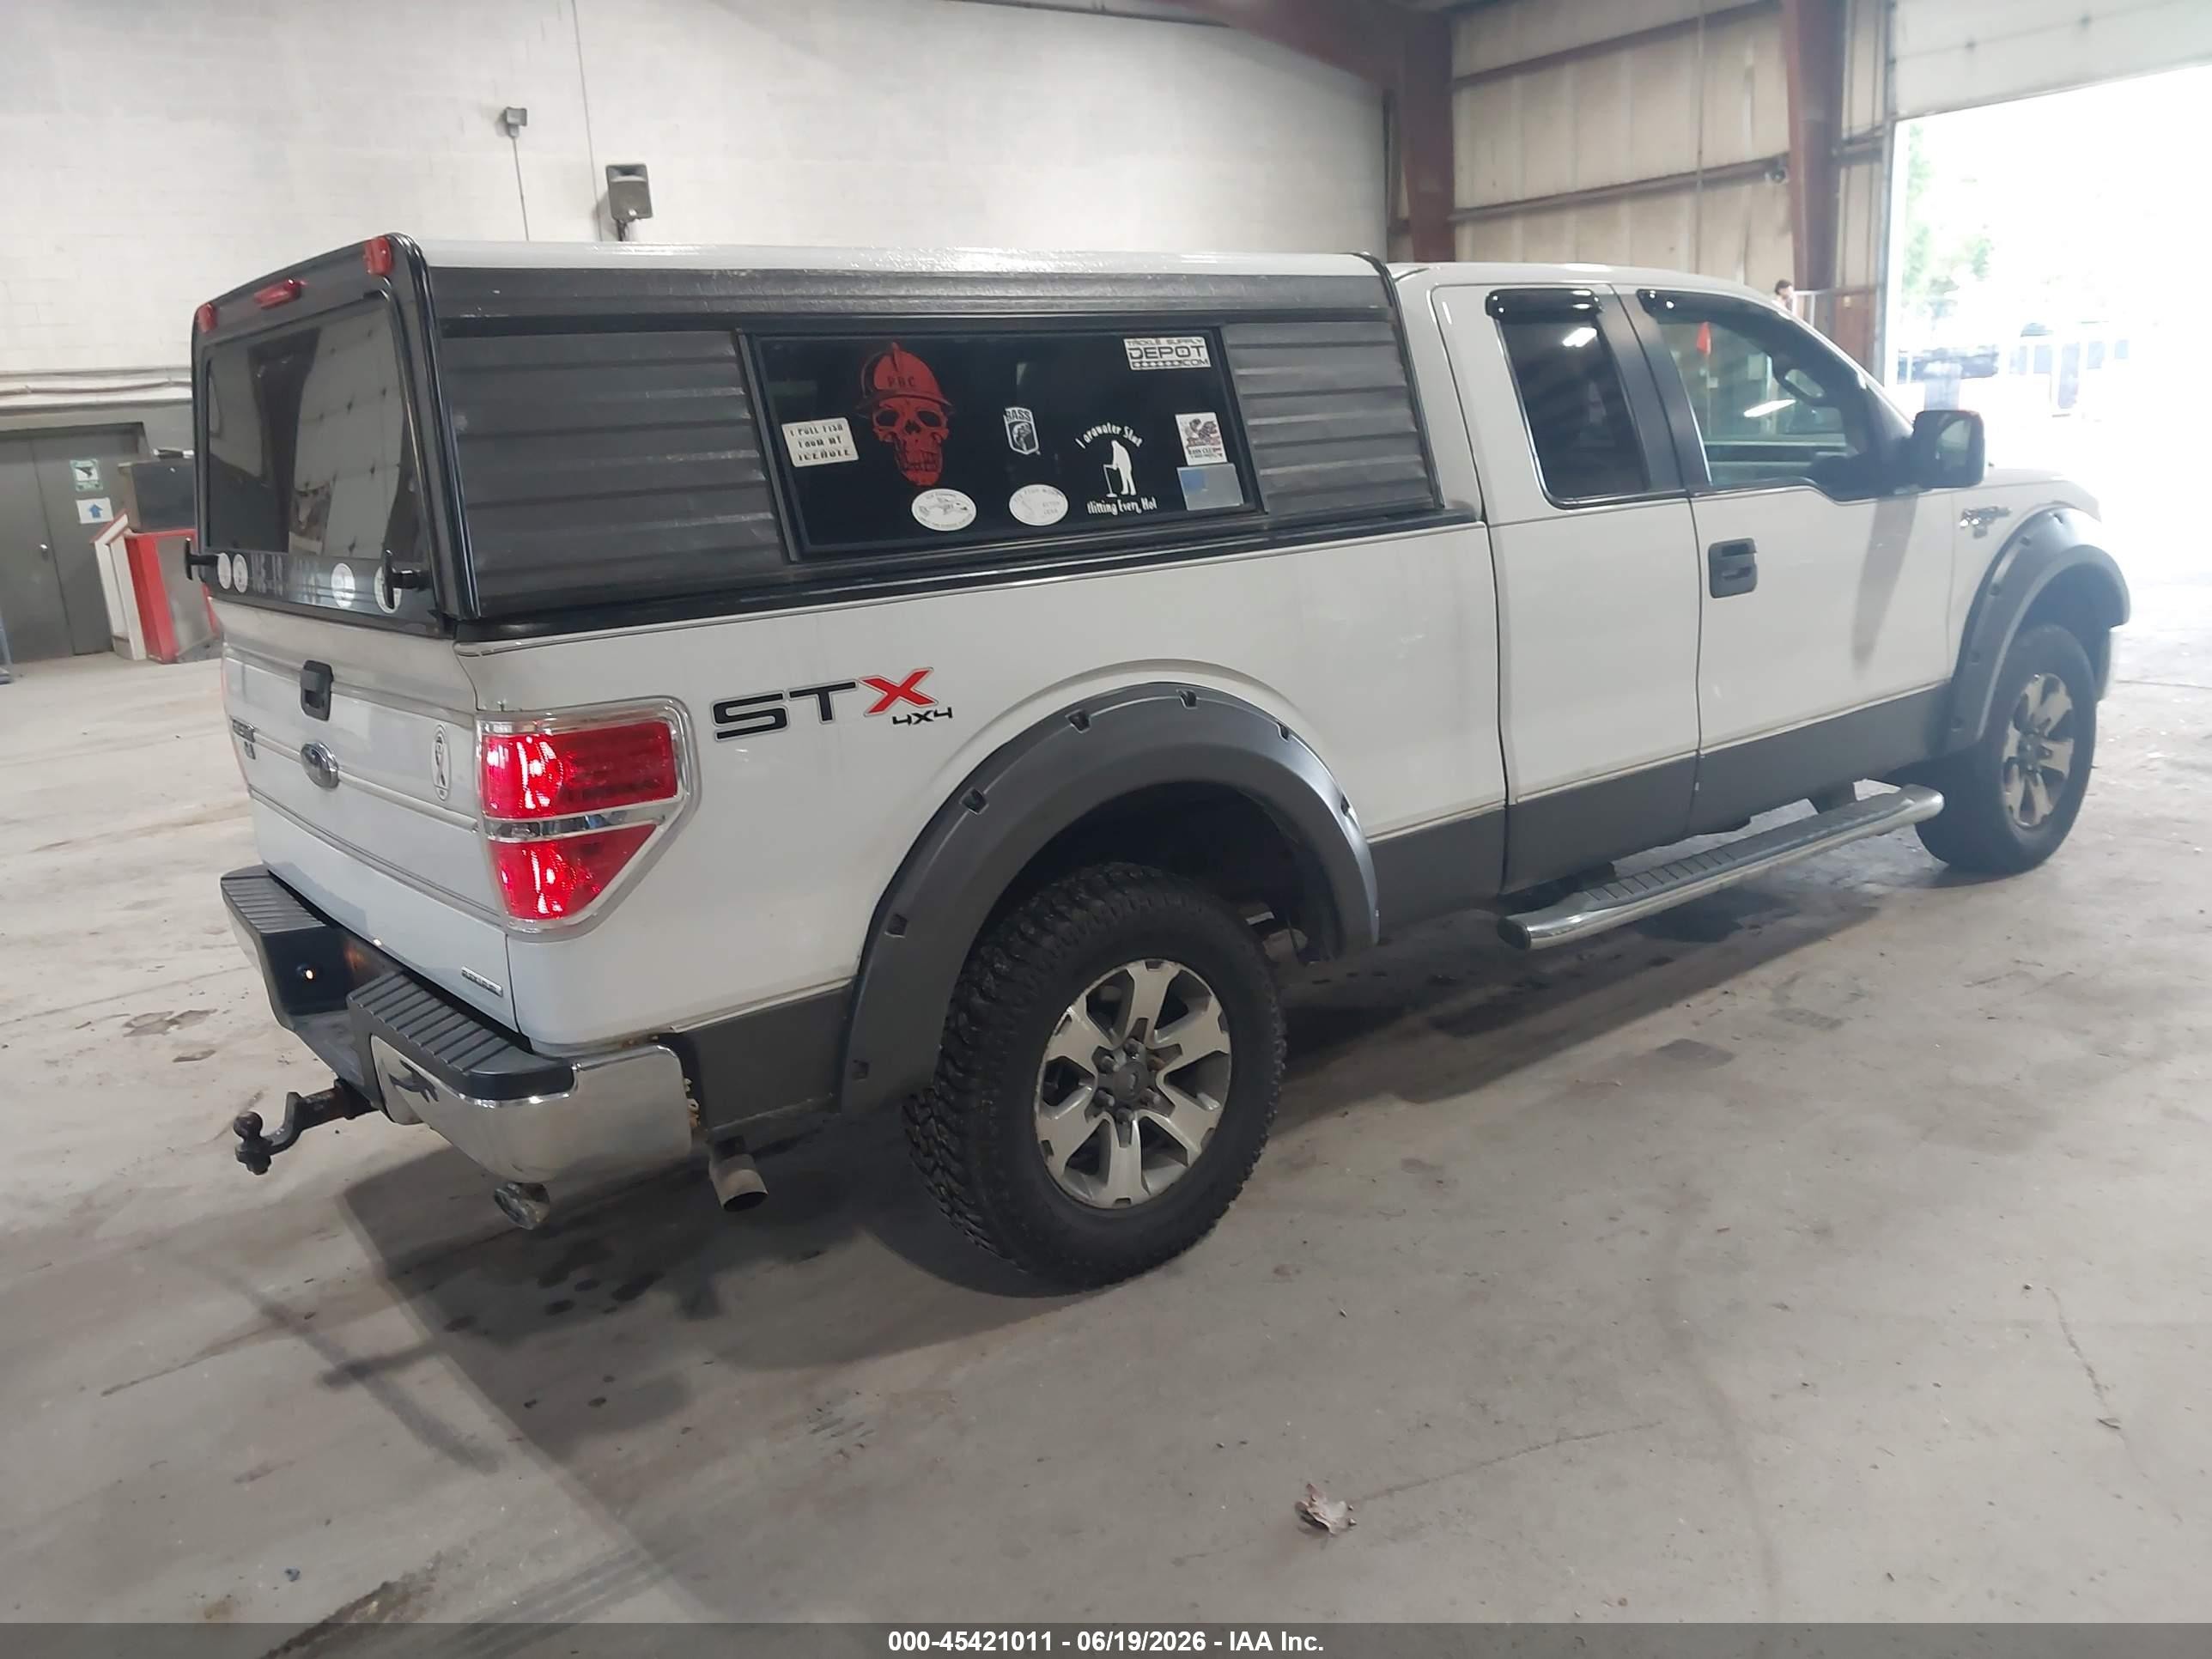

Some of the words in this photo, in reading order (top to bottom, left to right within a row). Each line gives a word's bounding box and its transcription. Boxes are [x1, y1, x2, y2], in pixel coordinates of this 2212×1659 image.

[1128, 345, 1205, 359] DEPOT
[1006, 410, 1030, 421] BASS
[712, 667, 937, 741] STX
